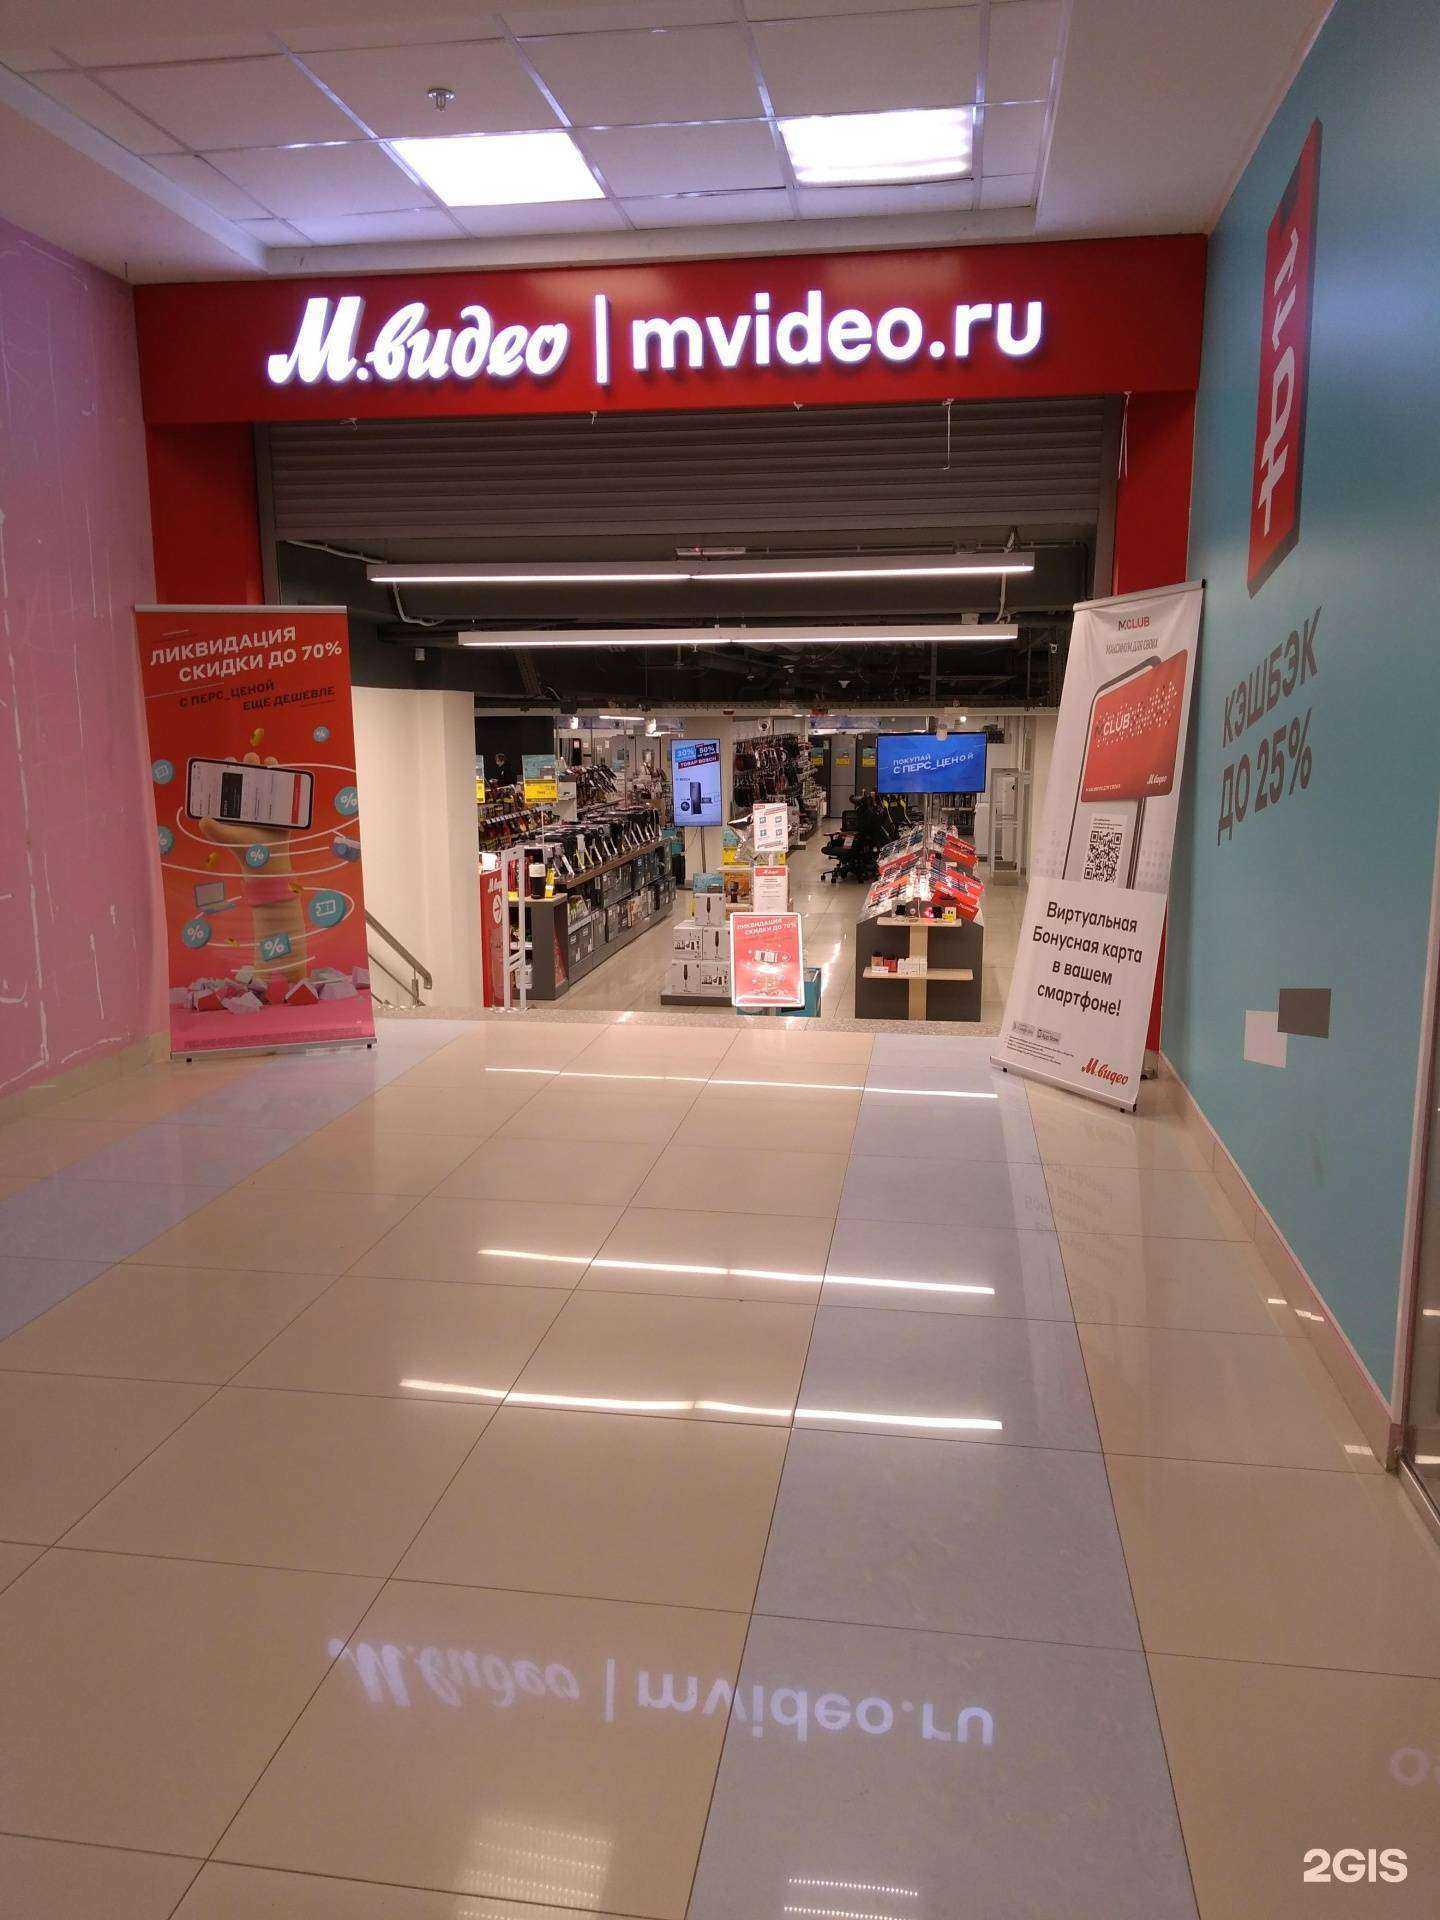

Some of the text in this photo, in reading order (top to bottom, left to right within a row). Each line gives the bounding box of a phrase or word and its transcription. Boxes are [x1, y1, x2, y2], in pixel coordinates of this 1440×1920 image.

[267, 295, 570, 384] М.видео
[631, 289, 1043, 371] mvideo.ru
[150, 626, 297, 666] ЛИКВИДАЦИЯ
[179, 640, 343, 683] СКИДКИ ДО 70%
[1222, 605, 1323, 749] КЭШБЭК
[272, 686, 336, 708] ДЕШЕВЛЕ
[1103, 713, 1131, 737] CLUB
[893, 752, 931, 766] ПОКУПАЙ
[893, 766, 901, 775] С
[1217, 707, 1313, 847] ДО 25%
[1046, 901, 1138, 933] Виртуальная
[1032, 925, 1143, 965] Бонусная карта
[1052, 959, 1113, 986] в вашем
[1037, 982, 1122, 1017] смартфоне!
[1080, 1056, 1129, 1086] М.видео
